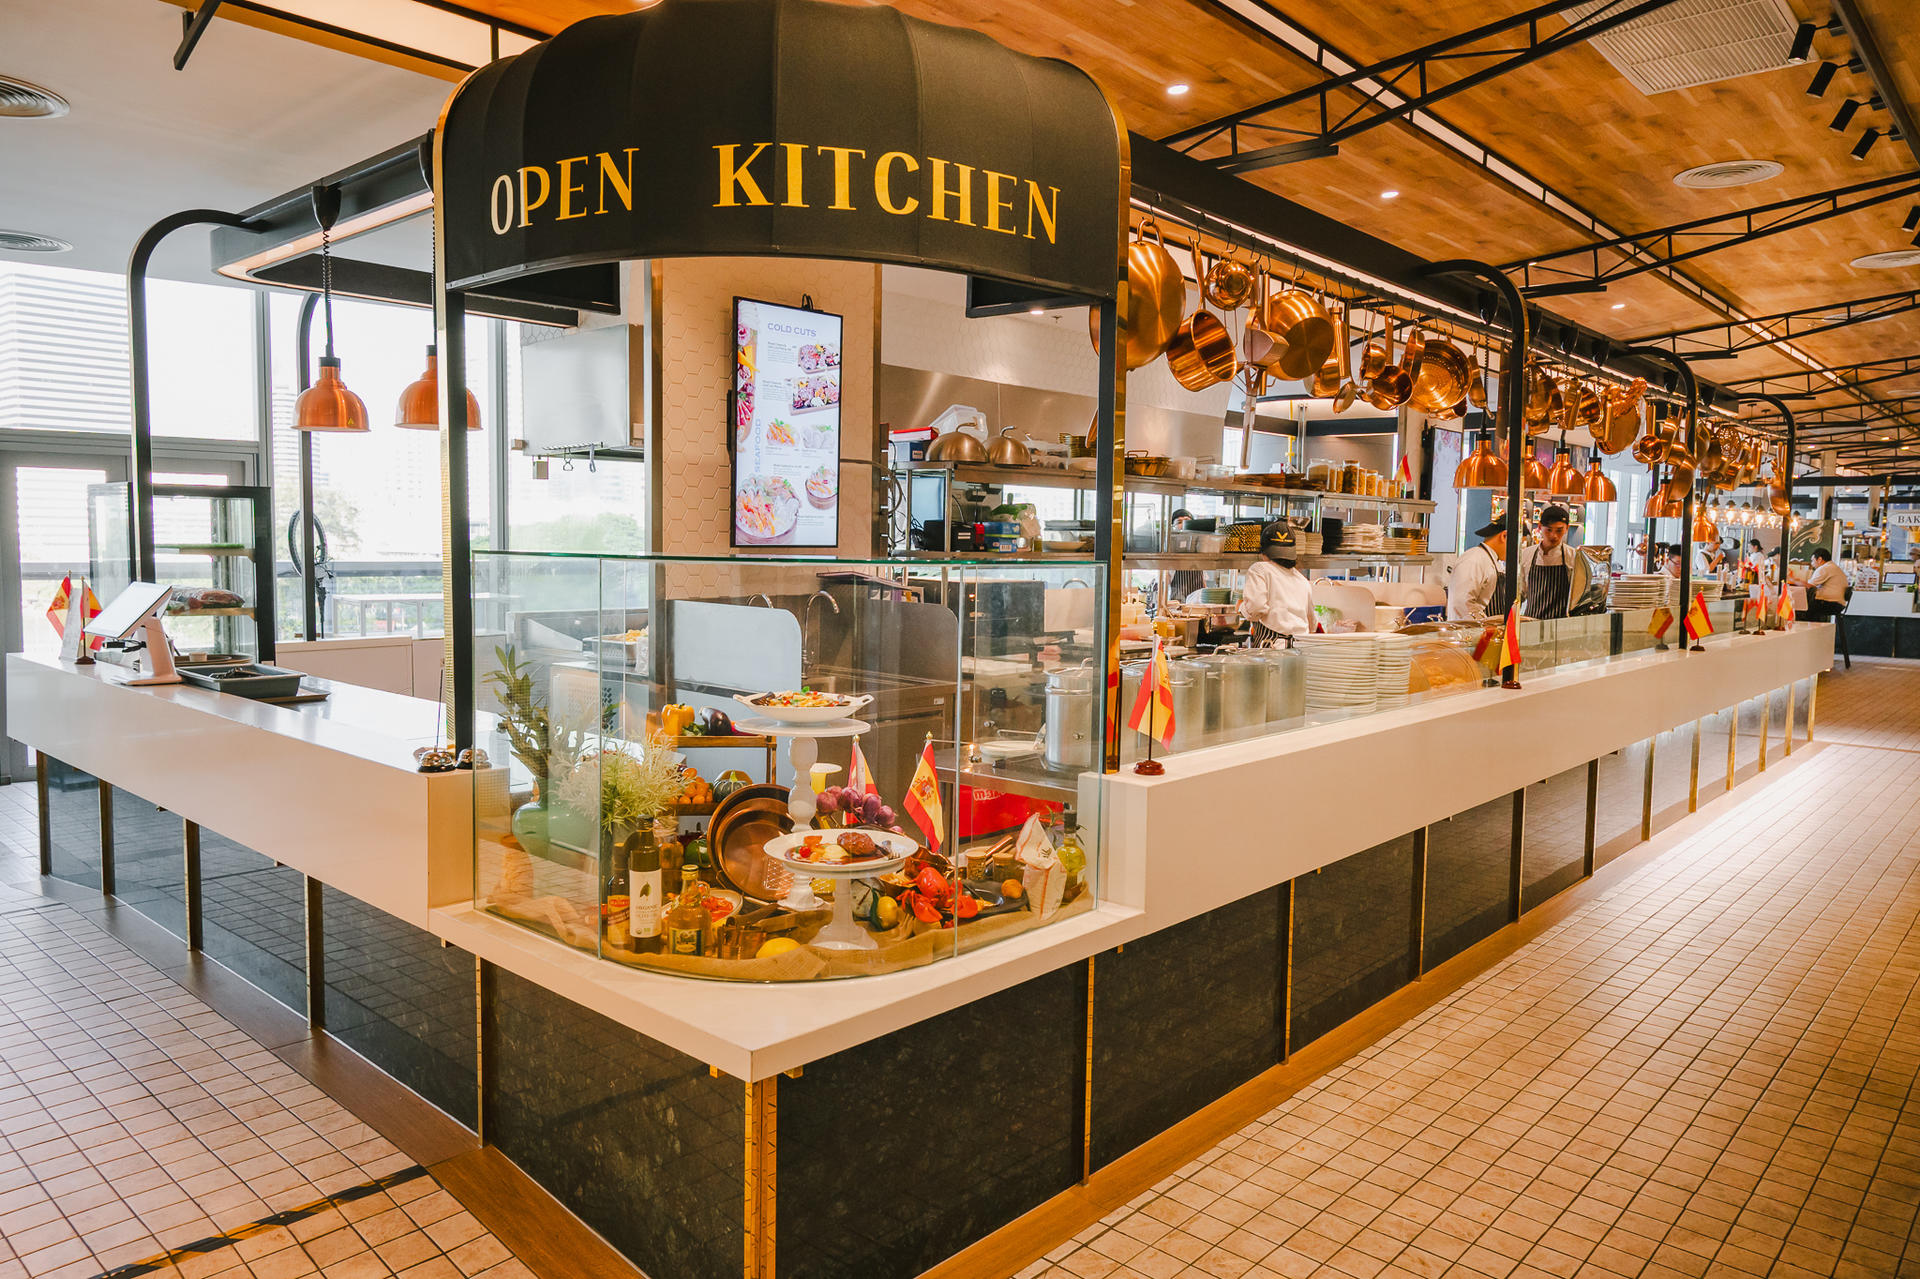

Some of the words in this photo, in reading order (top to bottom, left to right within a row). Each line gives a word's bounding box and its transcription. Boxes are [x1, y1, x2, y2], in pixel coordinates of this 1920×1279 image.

[491, 147, 639, 235] OPEN
[712, 142, 1061, 244] KITCHEN
[767, 322, 792, 333] COLD
[794, 327, 817, 337] CUTS
[1897, 515, 1920, 524] BAK
